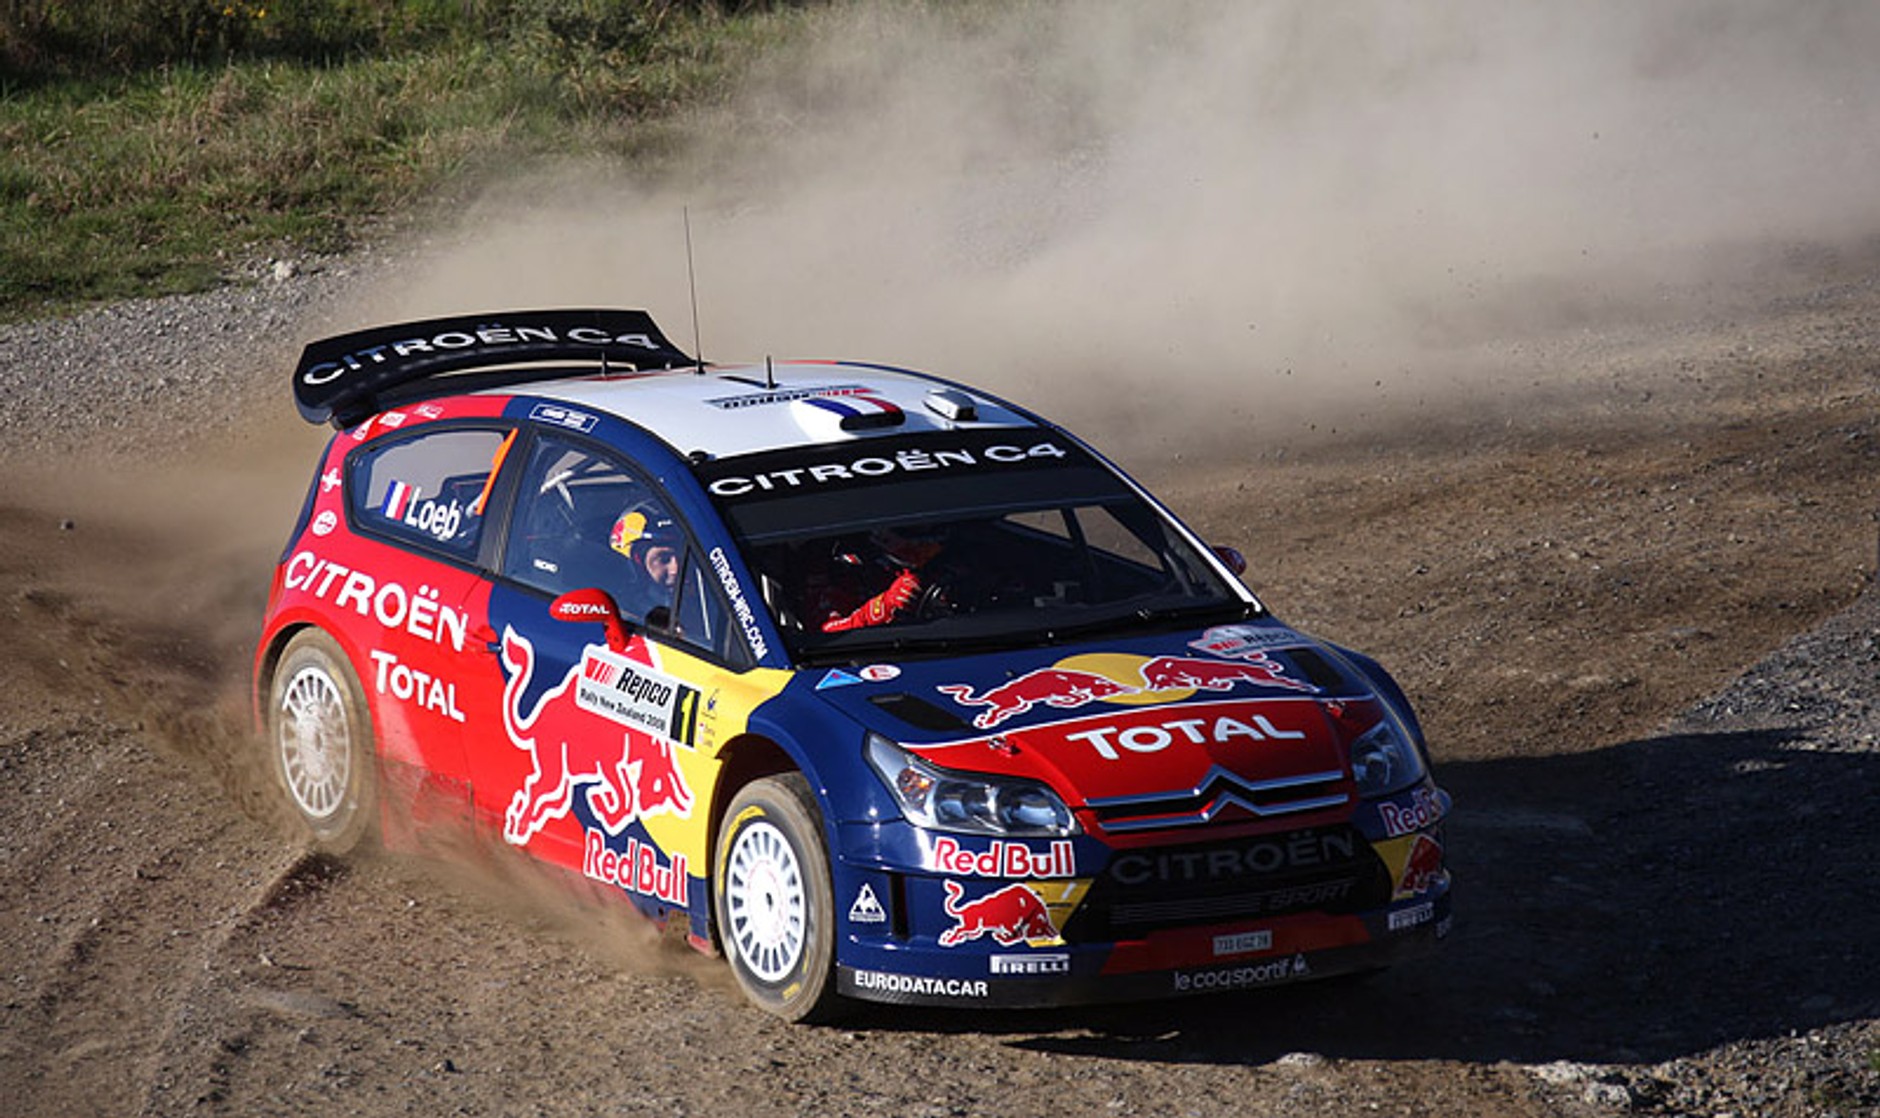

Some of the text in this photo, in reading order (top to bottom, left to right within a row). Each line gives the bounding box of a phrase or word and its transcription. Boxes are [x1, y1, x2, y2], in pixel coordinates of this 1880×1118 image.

[567, 327, 661, 350] C4
[707, 443, 1067, 496] CITROËN C4
[406, 487, 460, 541] Loeb
[284, 551, 468, 652] CITROËN
[370, 649, 466, 722] TOTAL
[616, 667, 672, 707] Repco
[681, 690, 696, 743] 1
[1067, 715, 1306, 761] TOTAL
[1110, 829, 1355, 884] CITROËN
[855, 969, 988, 997] EURODATACAR
[990, 953, 1070, 974] PIRELLI
[1174, 958, 1290, 991] le coq sportif
